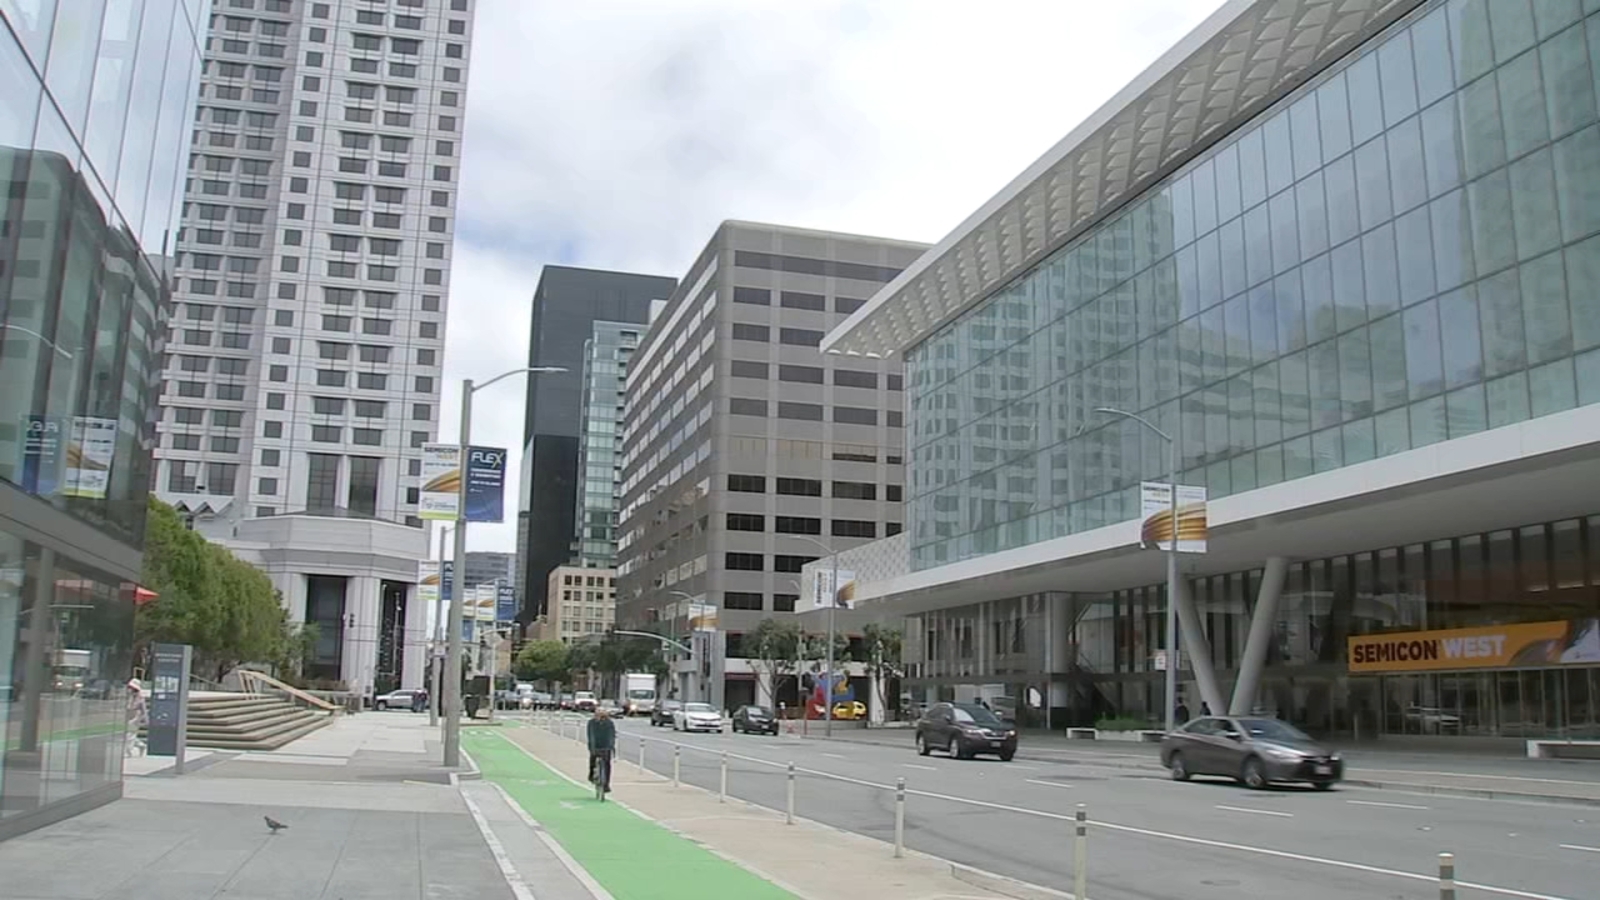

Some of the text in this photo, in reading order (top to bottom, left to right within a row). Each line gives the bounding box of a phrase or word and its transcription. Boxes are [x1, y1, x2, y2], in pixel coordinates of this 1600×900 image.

[471, 451, 504, 469] FLEX
[1353, 634, 1508, 664] SEMICON WEST
